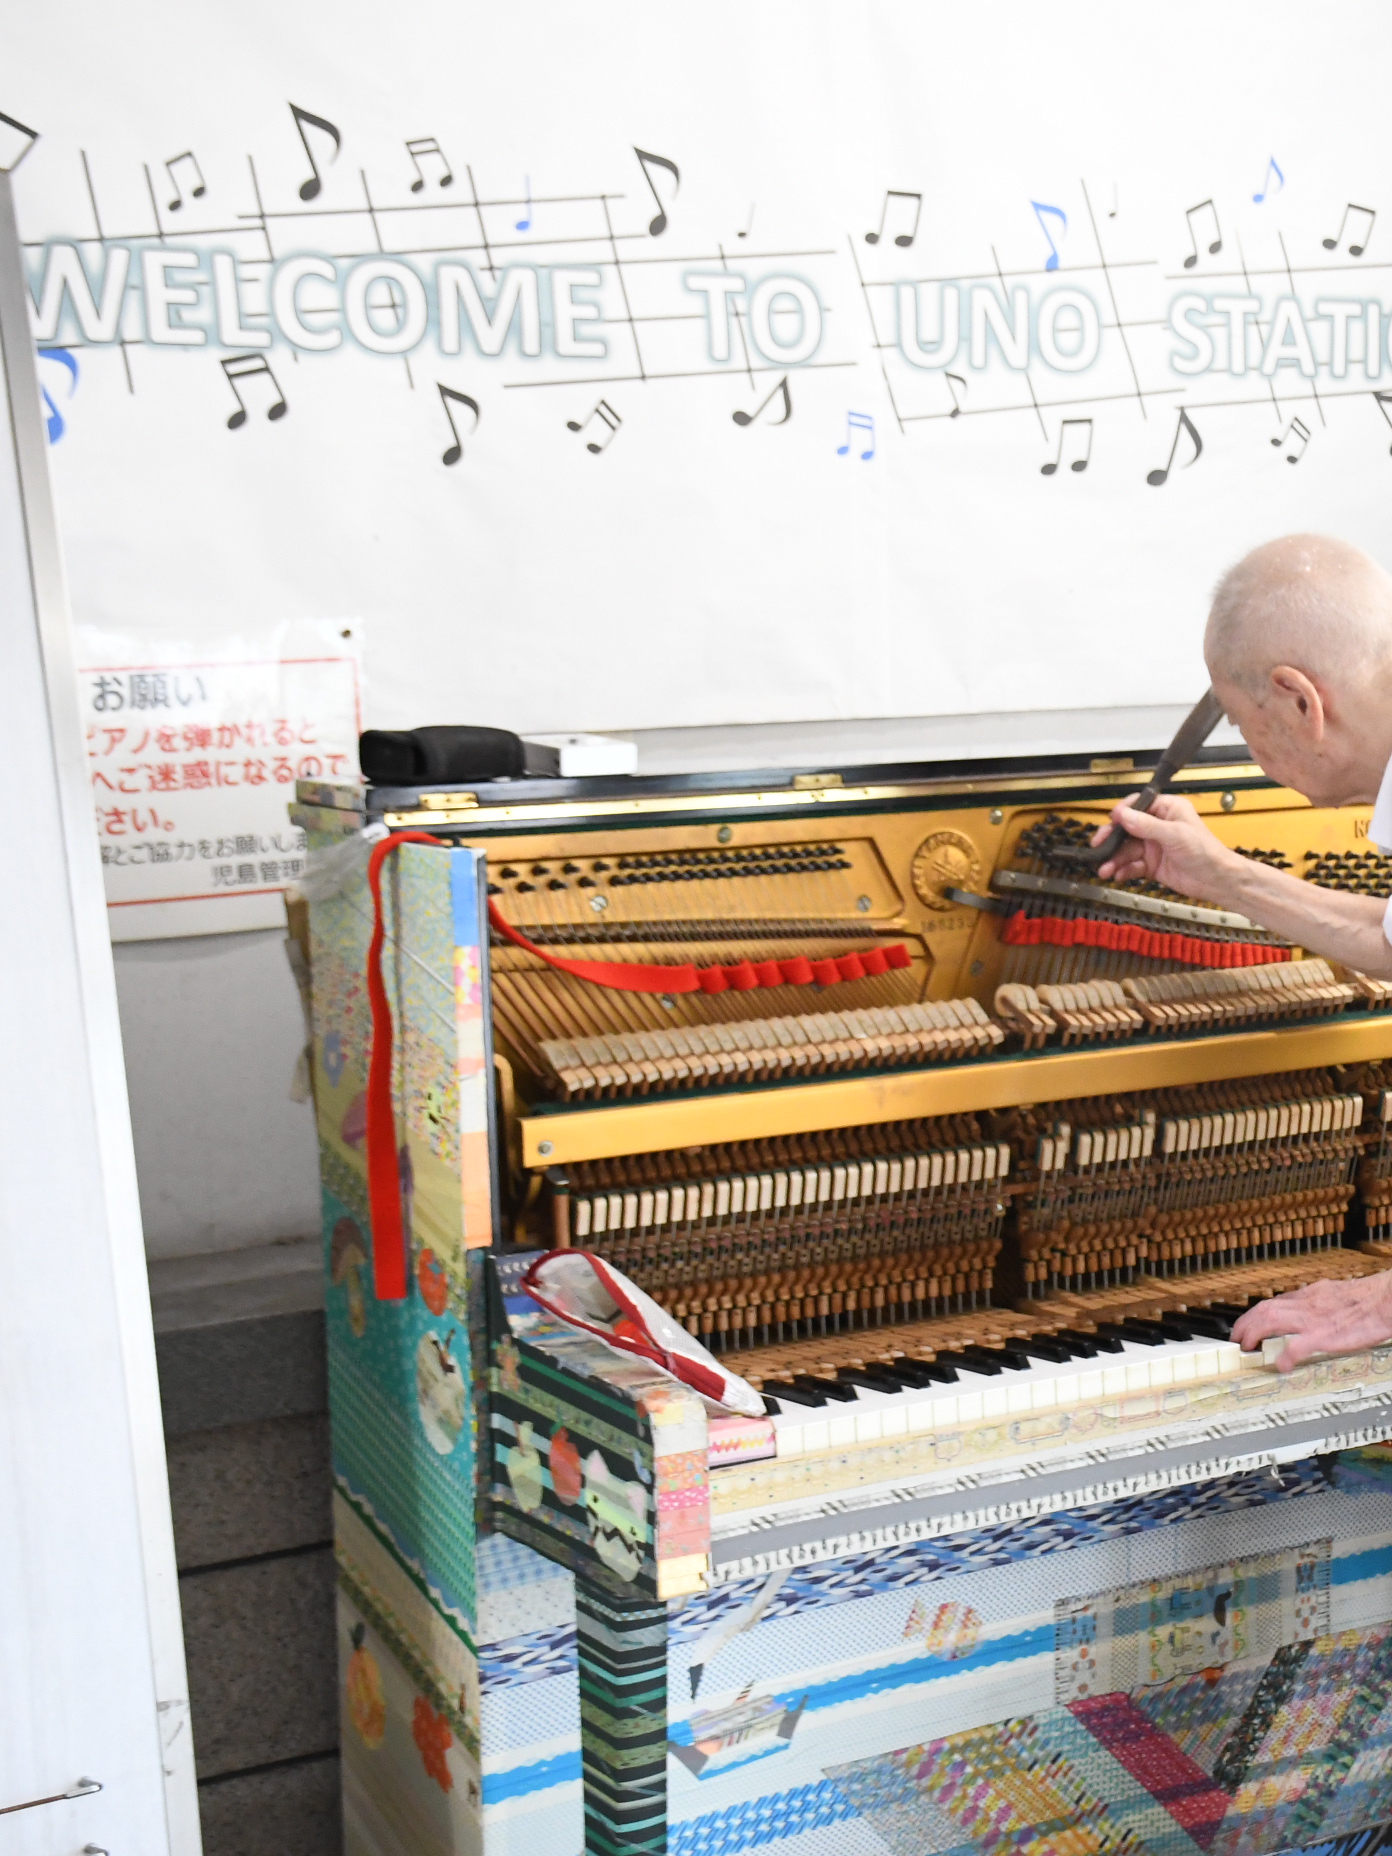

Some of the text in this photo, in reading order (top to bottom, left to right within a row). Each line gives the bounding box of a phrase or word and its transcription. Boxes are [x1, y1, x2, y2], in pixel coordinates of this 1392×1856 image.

[25, 242, 608, 359] WELCOME
[685, 272, 823, 365] TO
[898, 281, 1101, 373] UNO
[92, 673, 208, 712] お願い
